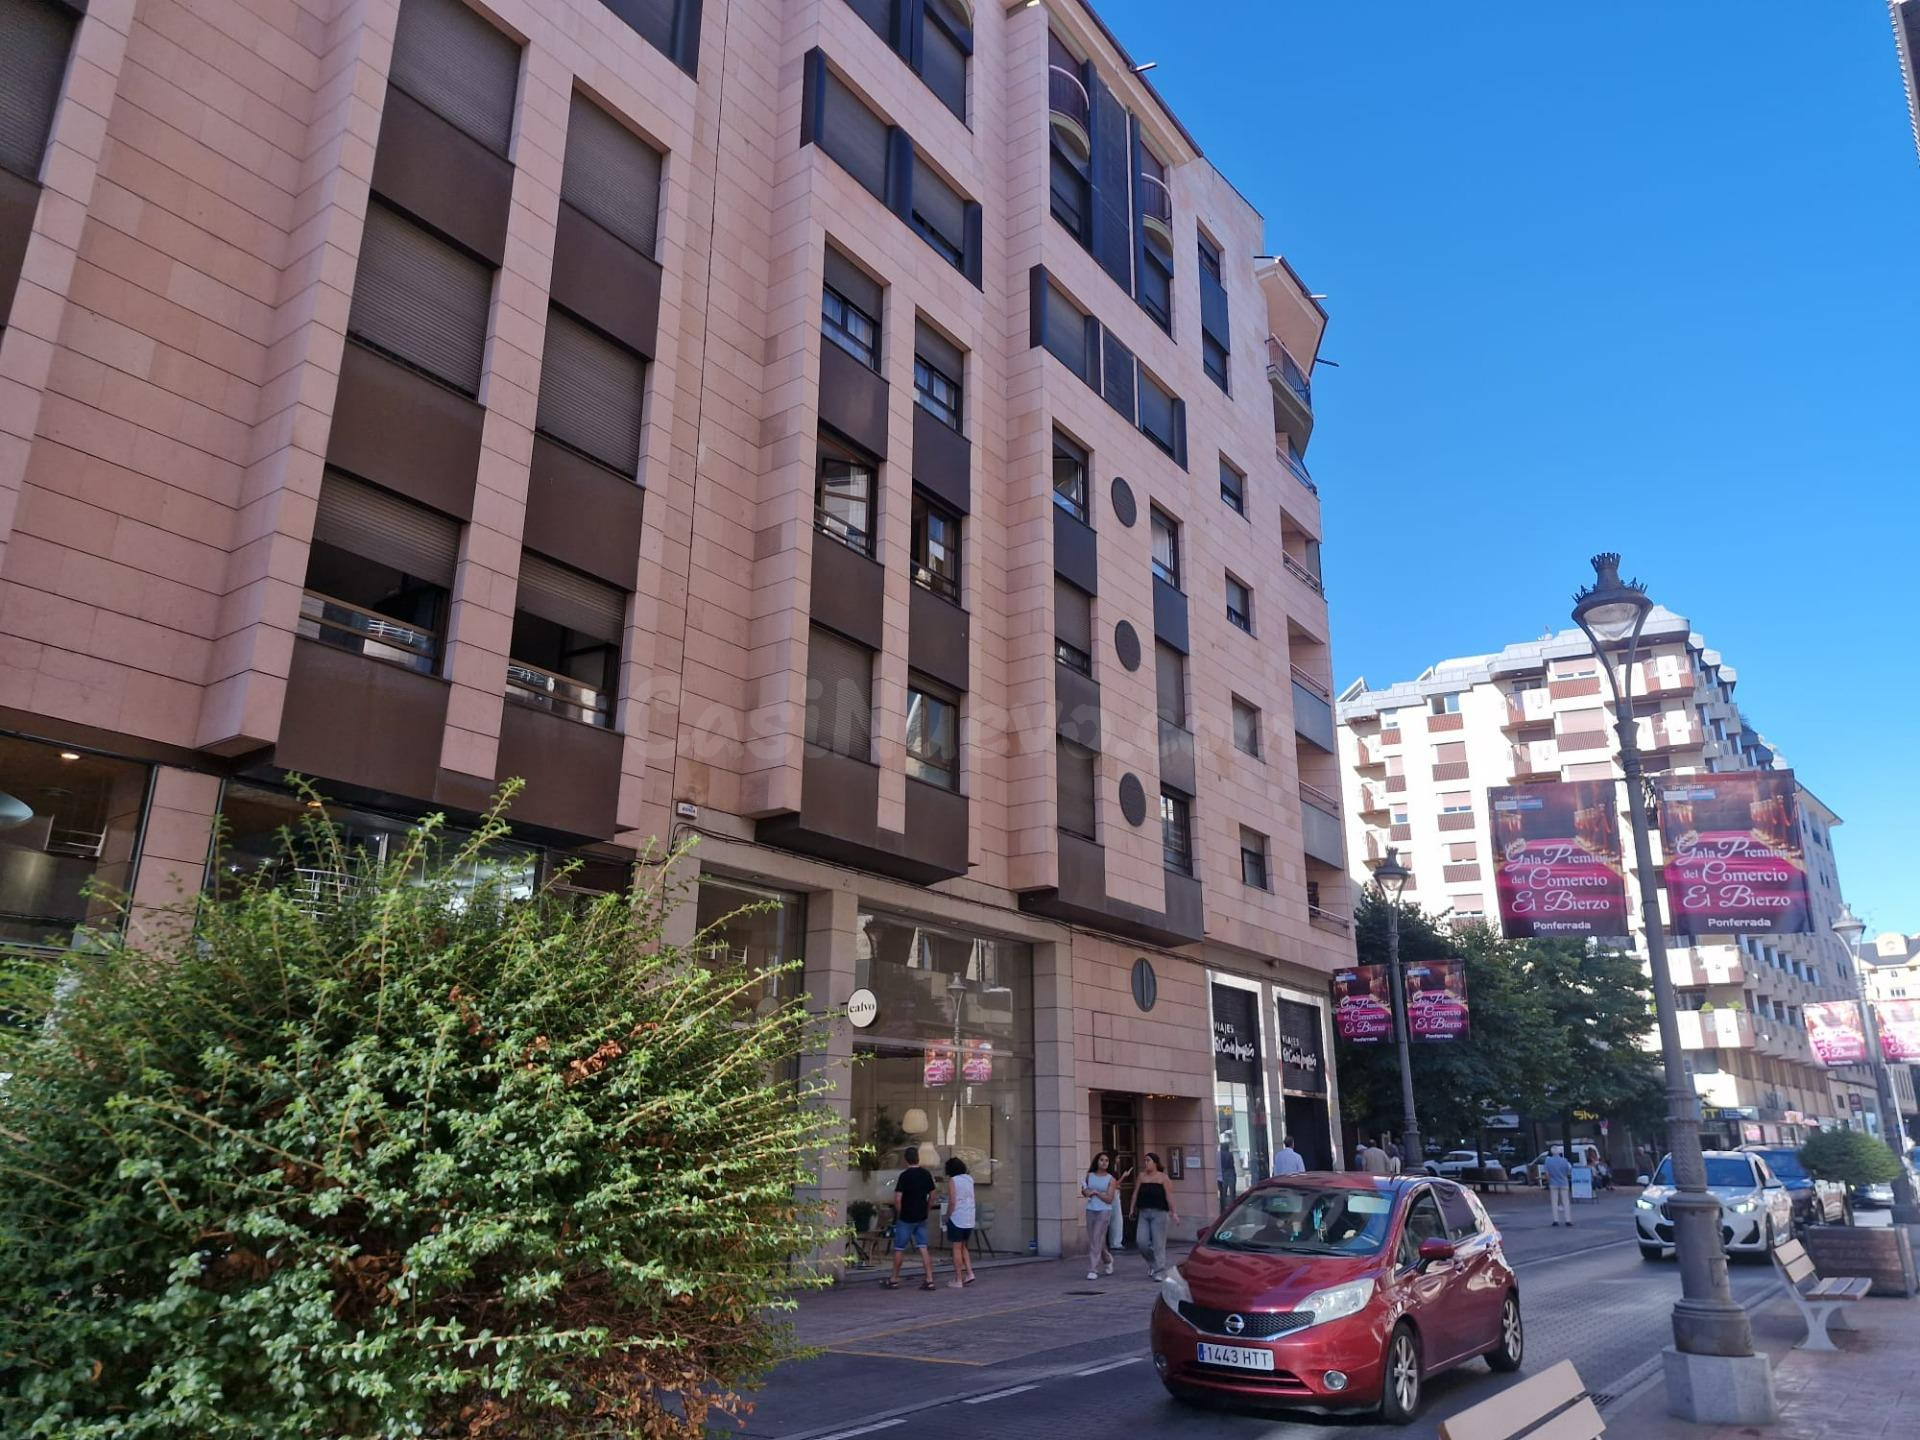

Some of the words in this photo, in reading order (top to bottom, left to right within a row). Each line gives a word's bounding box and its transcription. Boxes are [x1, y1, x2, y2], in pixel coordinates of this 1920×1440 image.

[1505, 841, 1542, 872] Gala
[1675, 836, 1716, 865] Gala
[1511, 875, 1526, 885] del
[1529, 867, 1608, 890] Comercio
[1683, 869, 1698, 879] del
[1702, 861, 1788, 885] Comercio
[1512, 891, 1537, 913] El
[1545, 890, 1610, 911] Bierzo
[1683, 885, 1711, 909] El
[1719, 884, 1791, 908] Bierzo
[1533, 921, 1592, 930] Ponferrada
[1707, 917, 1771, 928] Ponferrada
[1208, 1347, 1239, 1364] 1443
[1242, 1351, 1269, 1367] HTT
